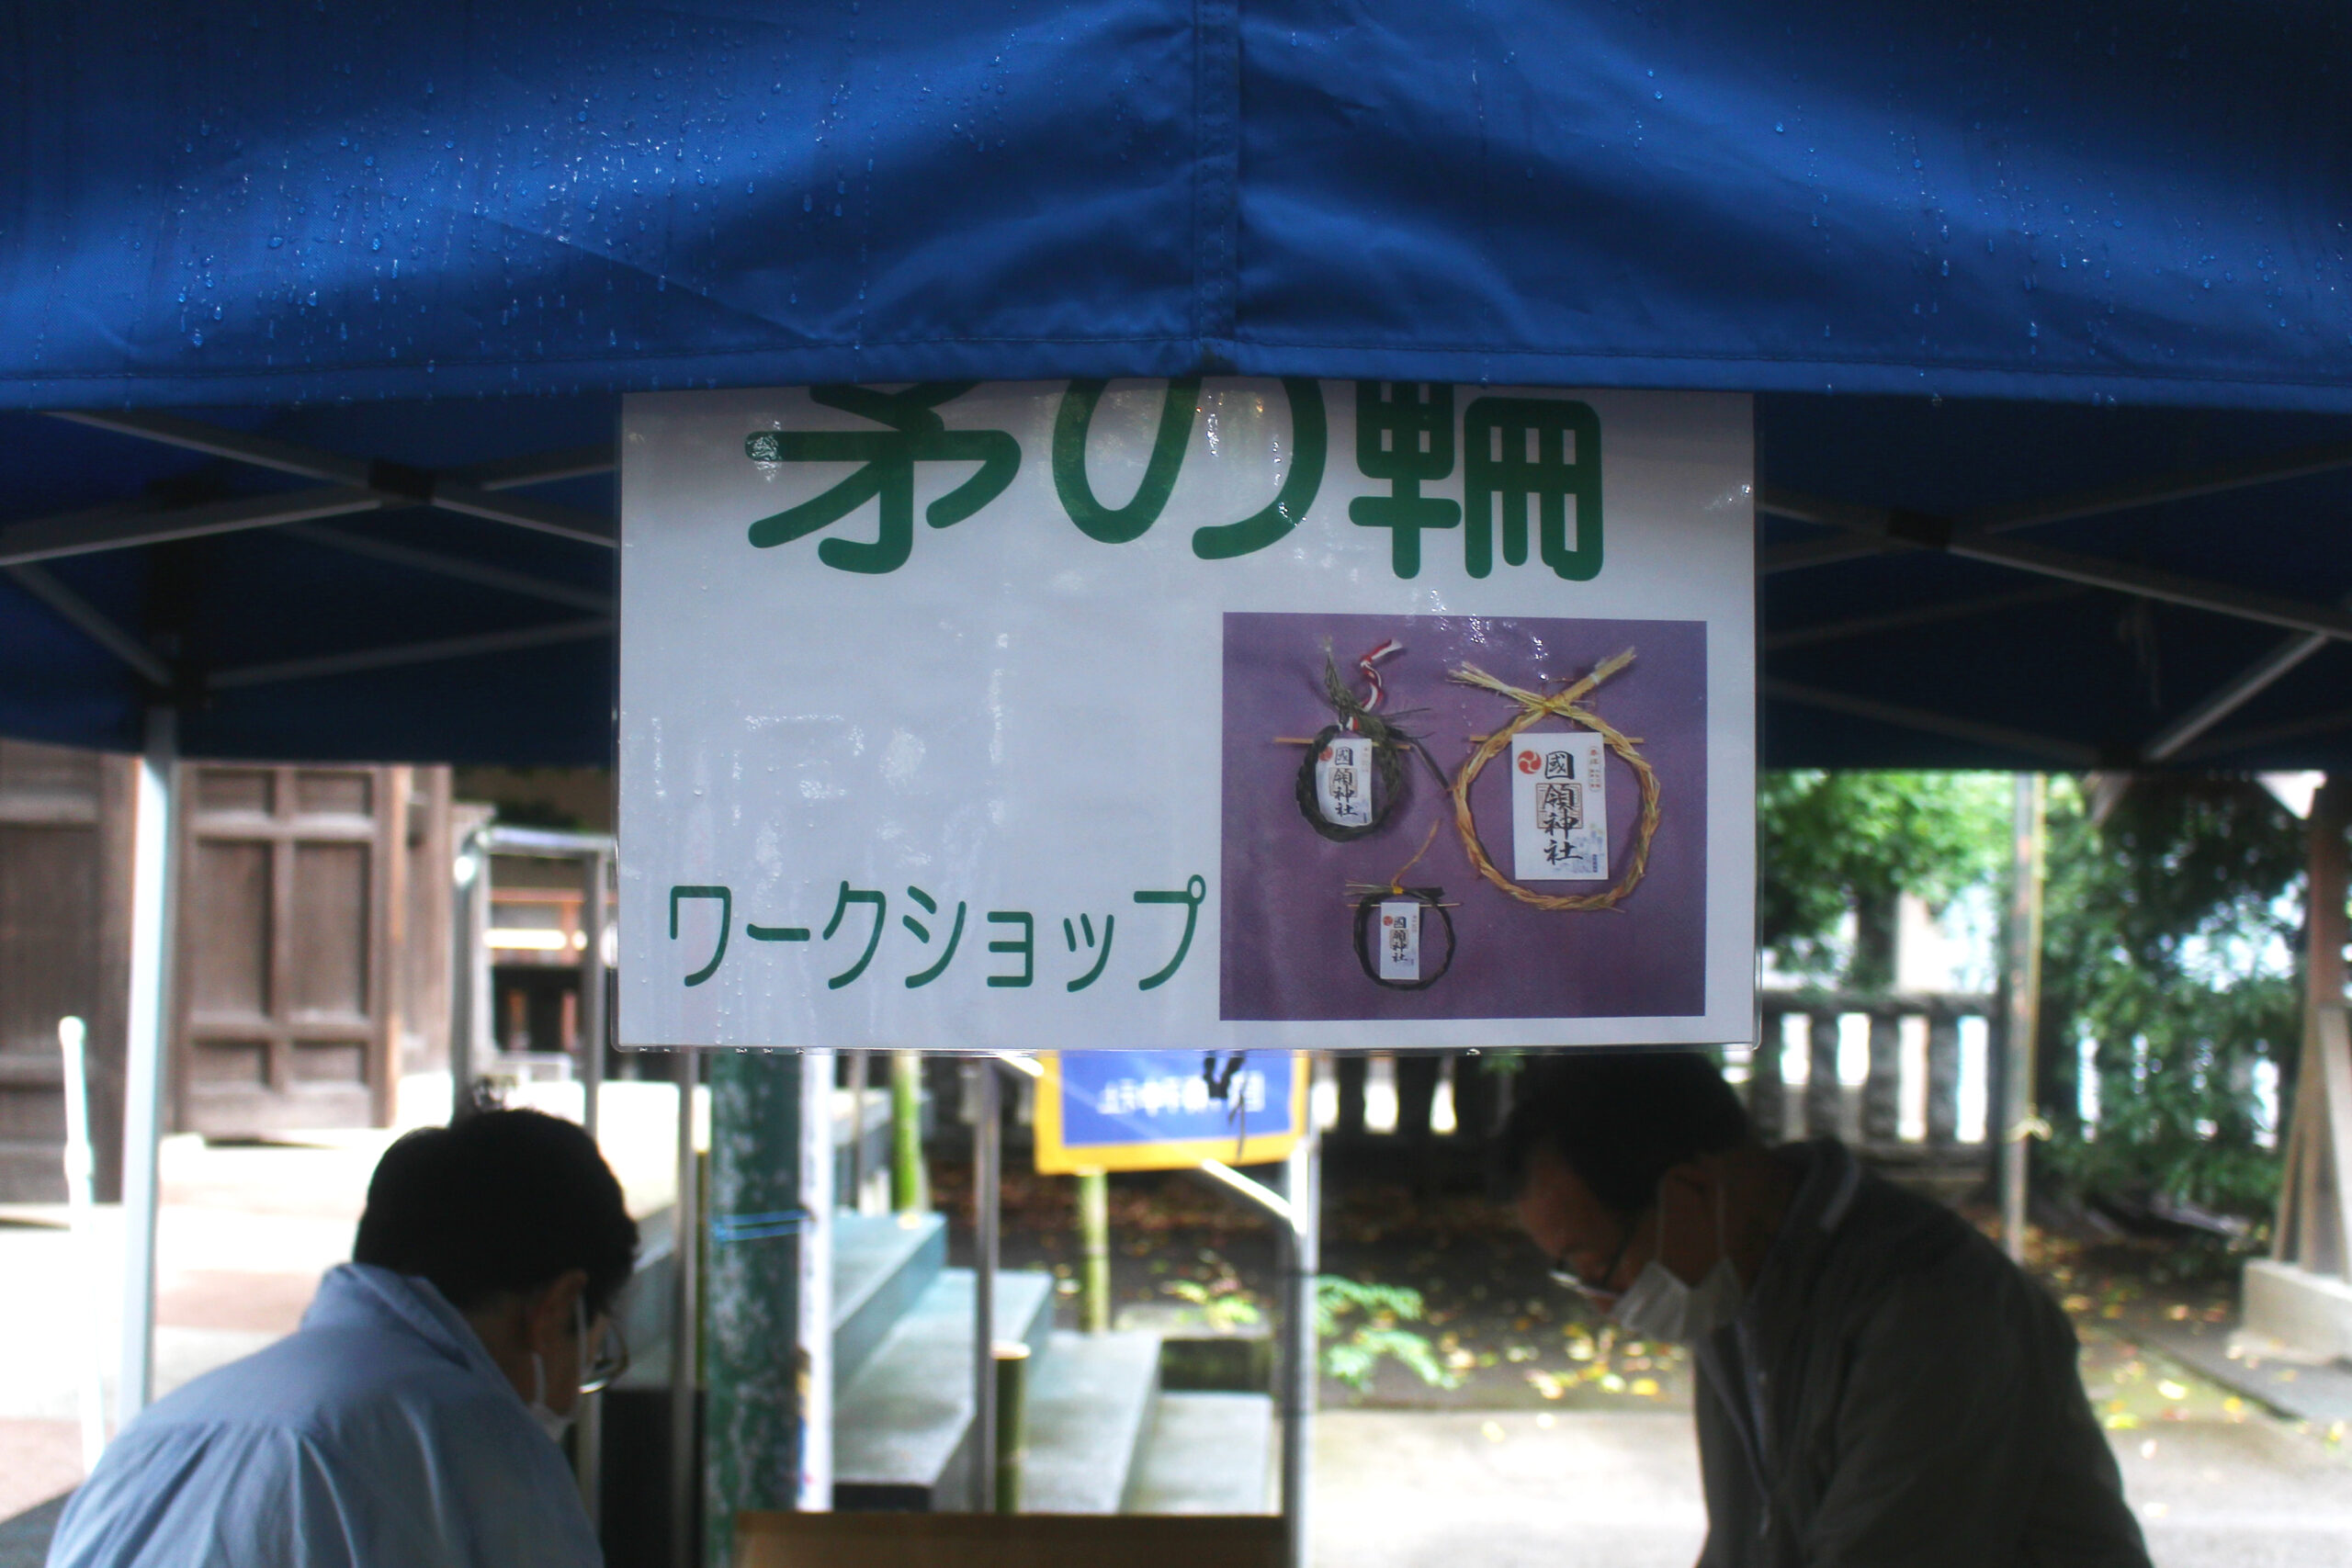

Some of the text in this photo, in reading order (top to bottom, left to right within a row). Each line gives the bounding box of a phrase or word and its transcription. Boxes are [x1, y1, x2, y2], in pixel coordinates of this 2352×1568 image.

[669, 874, 1206, 993] ワークショップ
